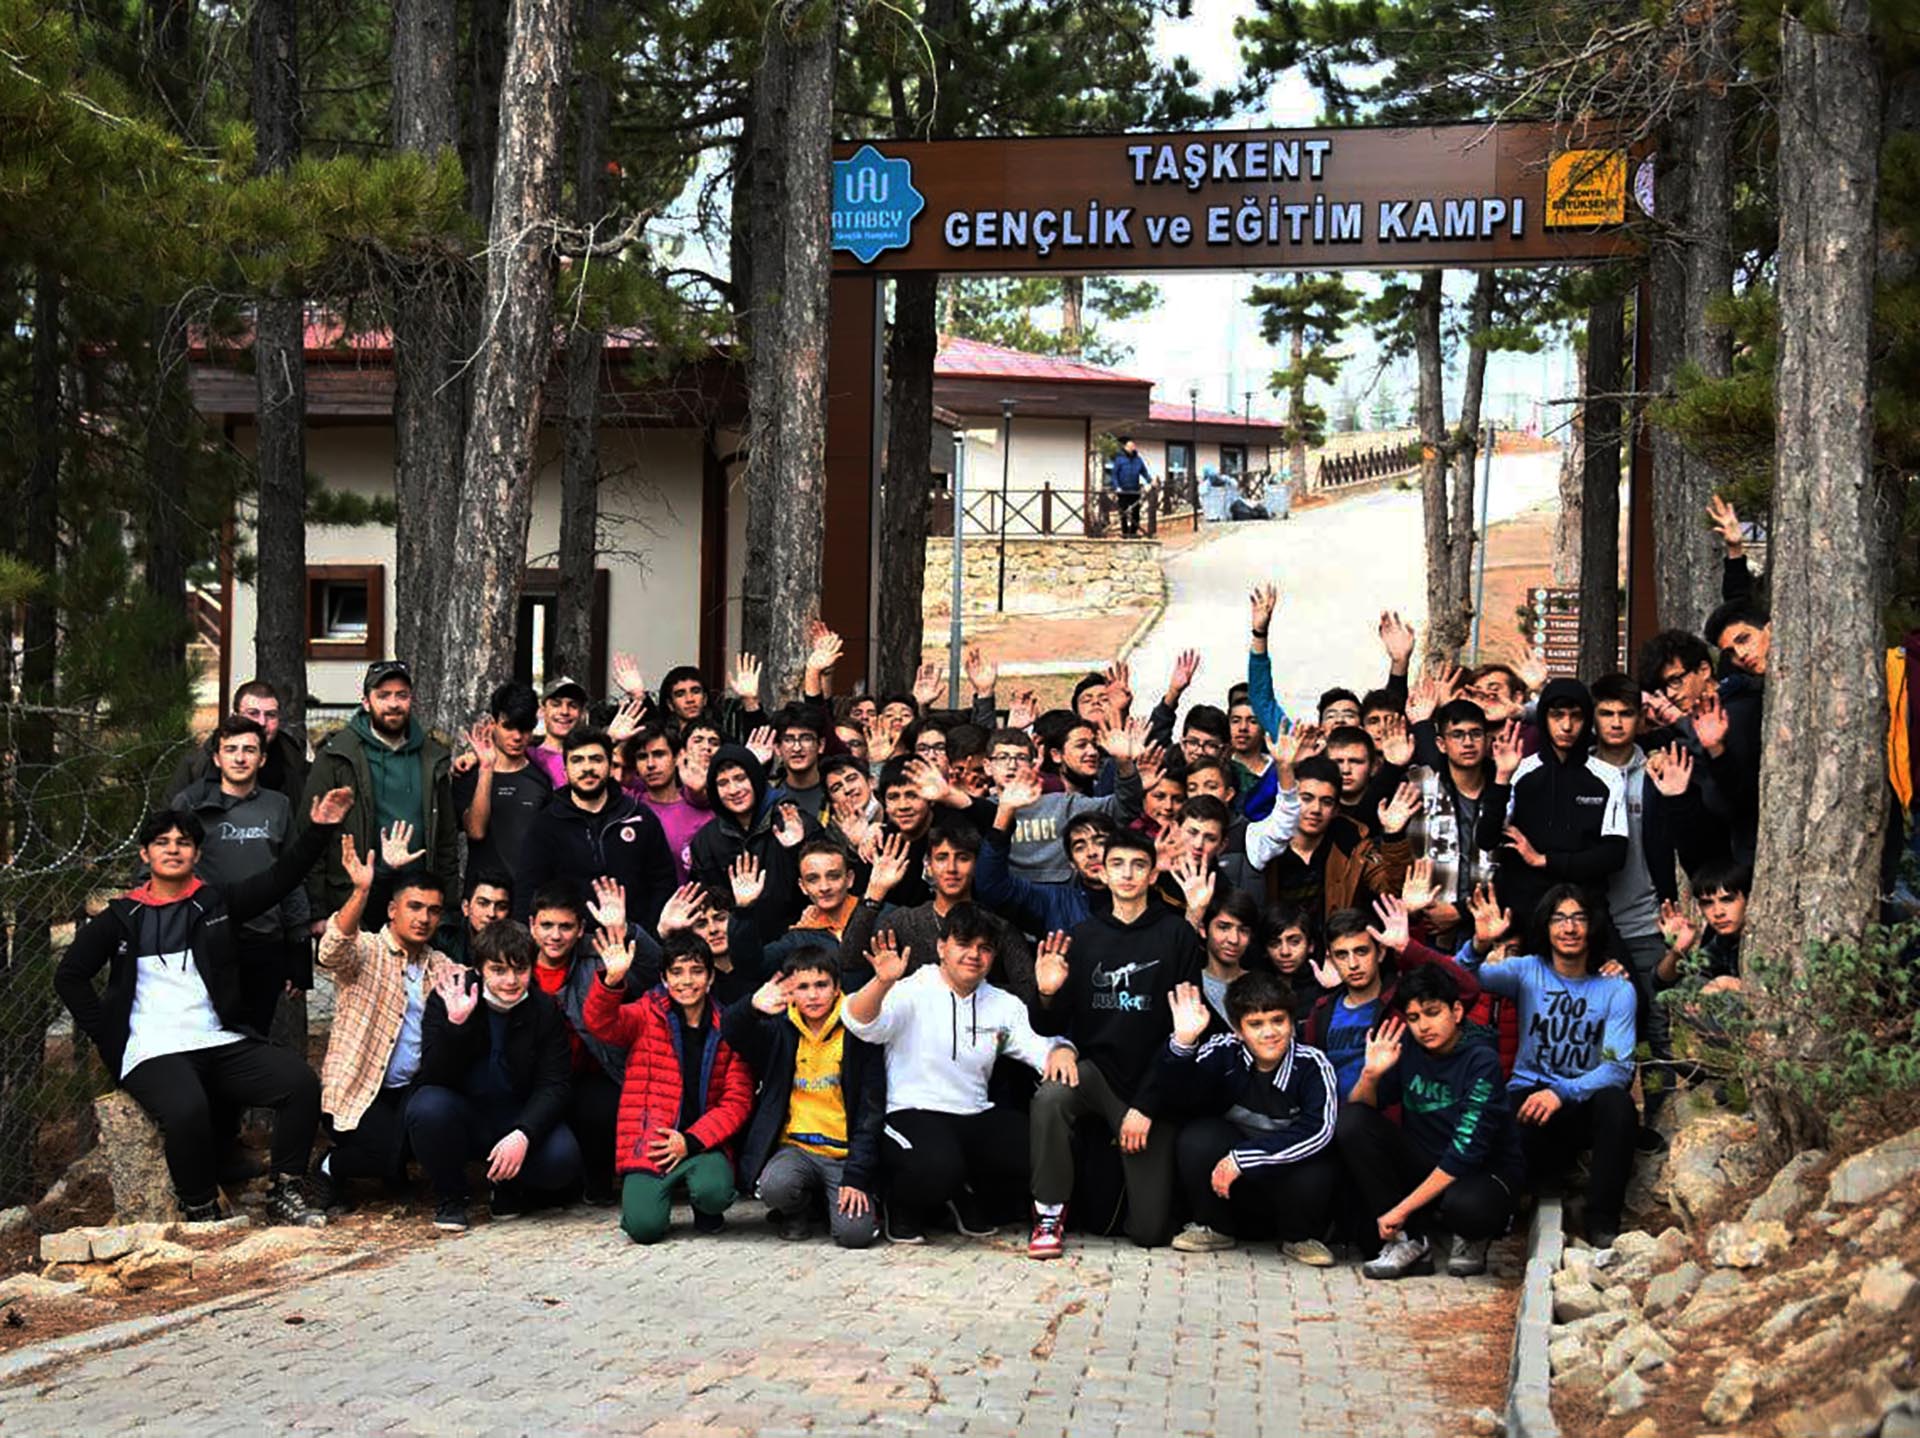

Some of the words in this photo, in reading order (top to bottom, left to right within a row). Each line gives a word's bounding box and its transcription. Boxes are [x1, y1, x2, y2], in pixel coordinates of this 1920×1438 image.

[1127, 140, 1331, 189] TAŞKENT
[944, 201, 1132, 255] GENÇLİK
[1145, 215, 1192, 244] ve
[1207, 195, 1363, 242] EĞİTİM
[1378, 198, 1524, 239] KAMPI
[1528, 1012, 1606, 1049] MUCH
[1536, 1043, 1592, 1070] FUN
